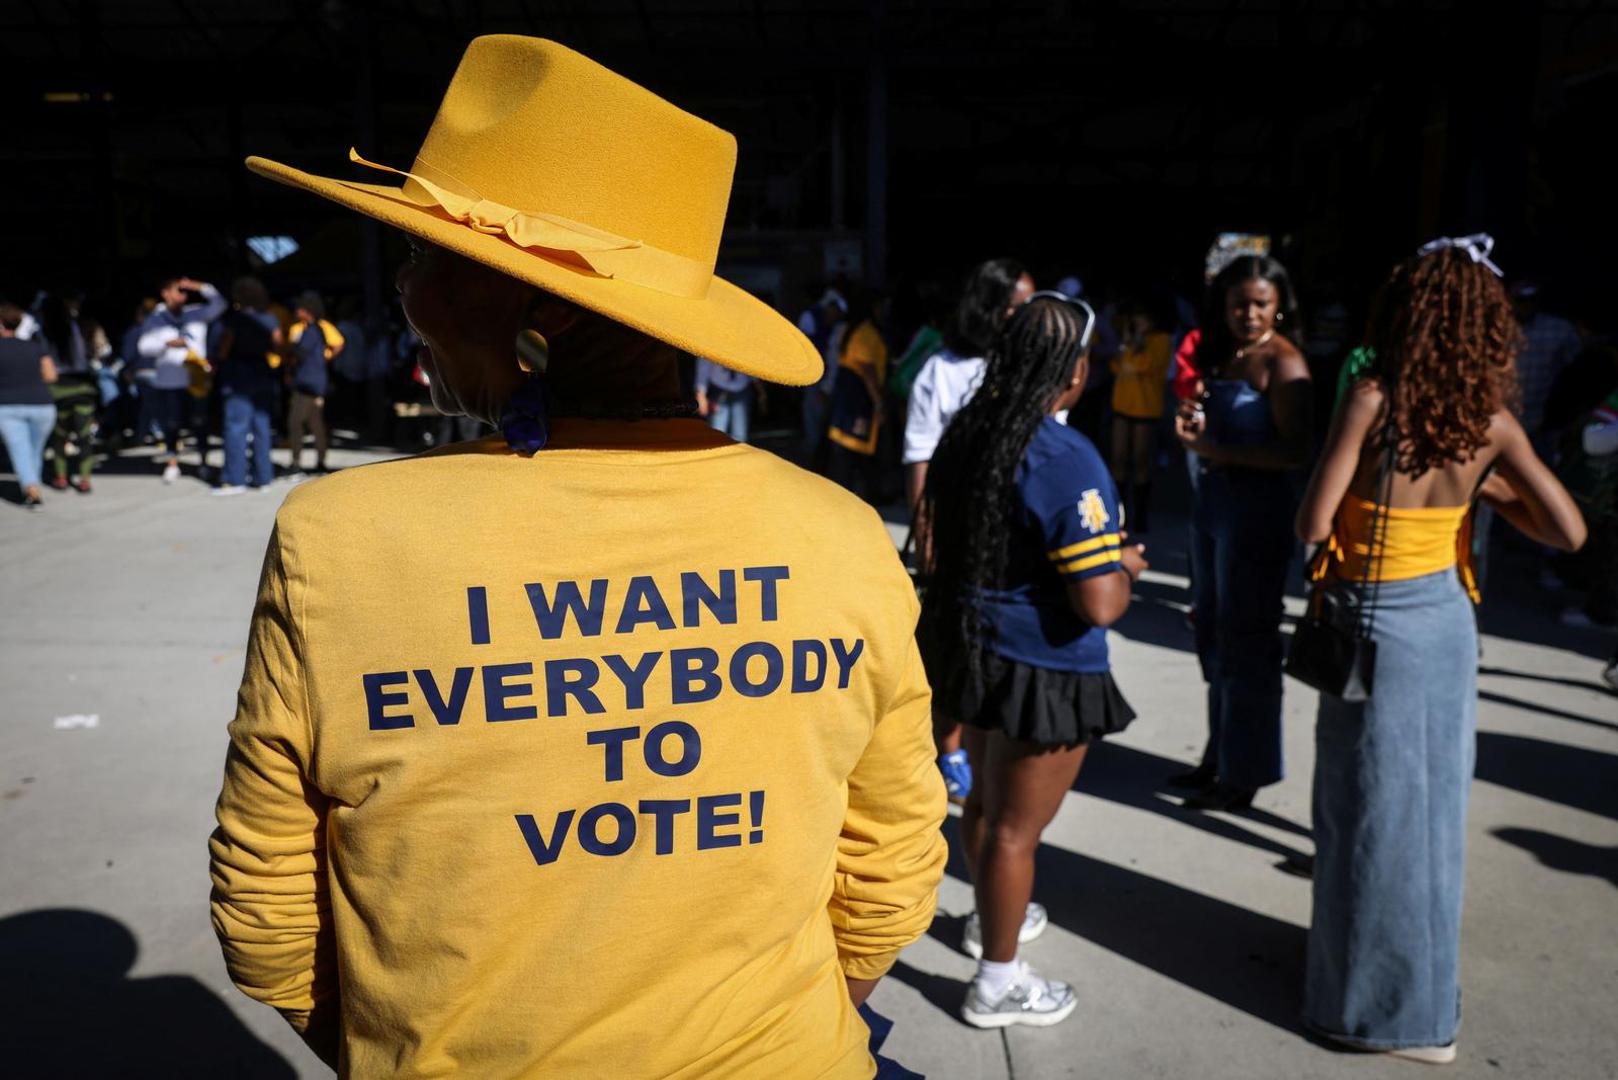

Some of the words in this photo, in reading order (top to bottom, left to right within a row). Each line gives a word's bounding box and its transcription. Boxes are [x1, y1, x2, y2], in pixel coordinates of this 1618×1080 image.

[467, 587, 491, 645] I
[525, 566, 790, 640] WANT
[363, 638, 864, 730] EVERYBODY
[587, 721, 702, 782] TO
[515, 790, 765, 866] VOTE!
